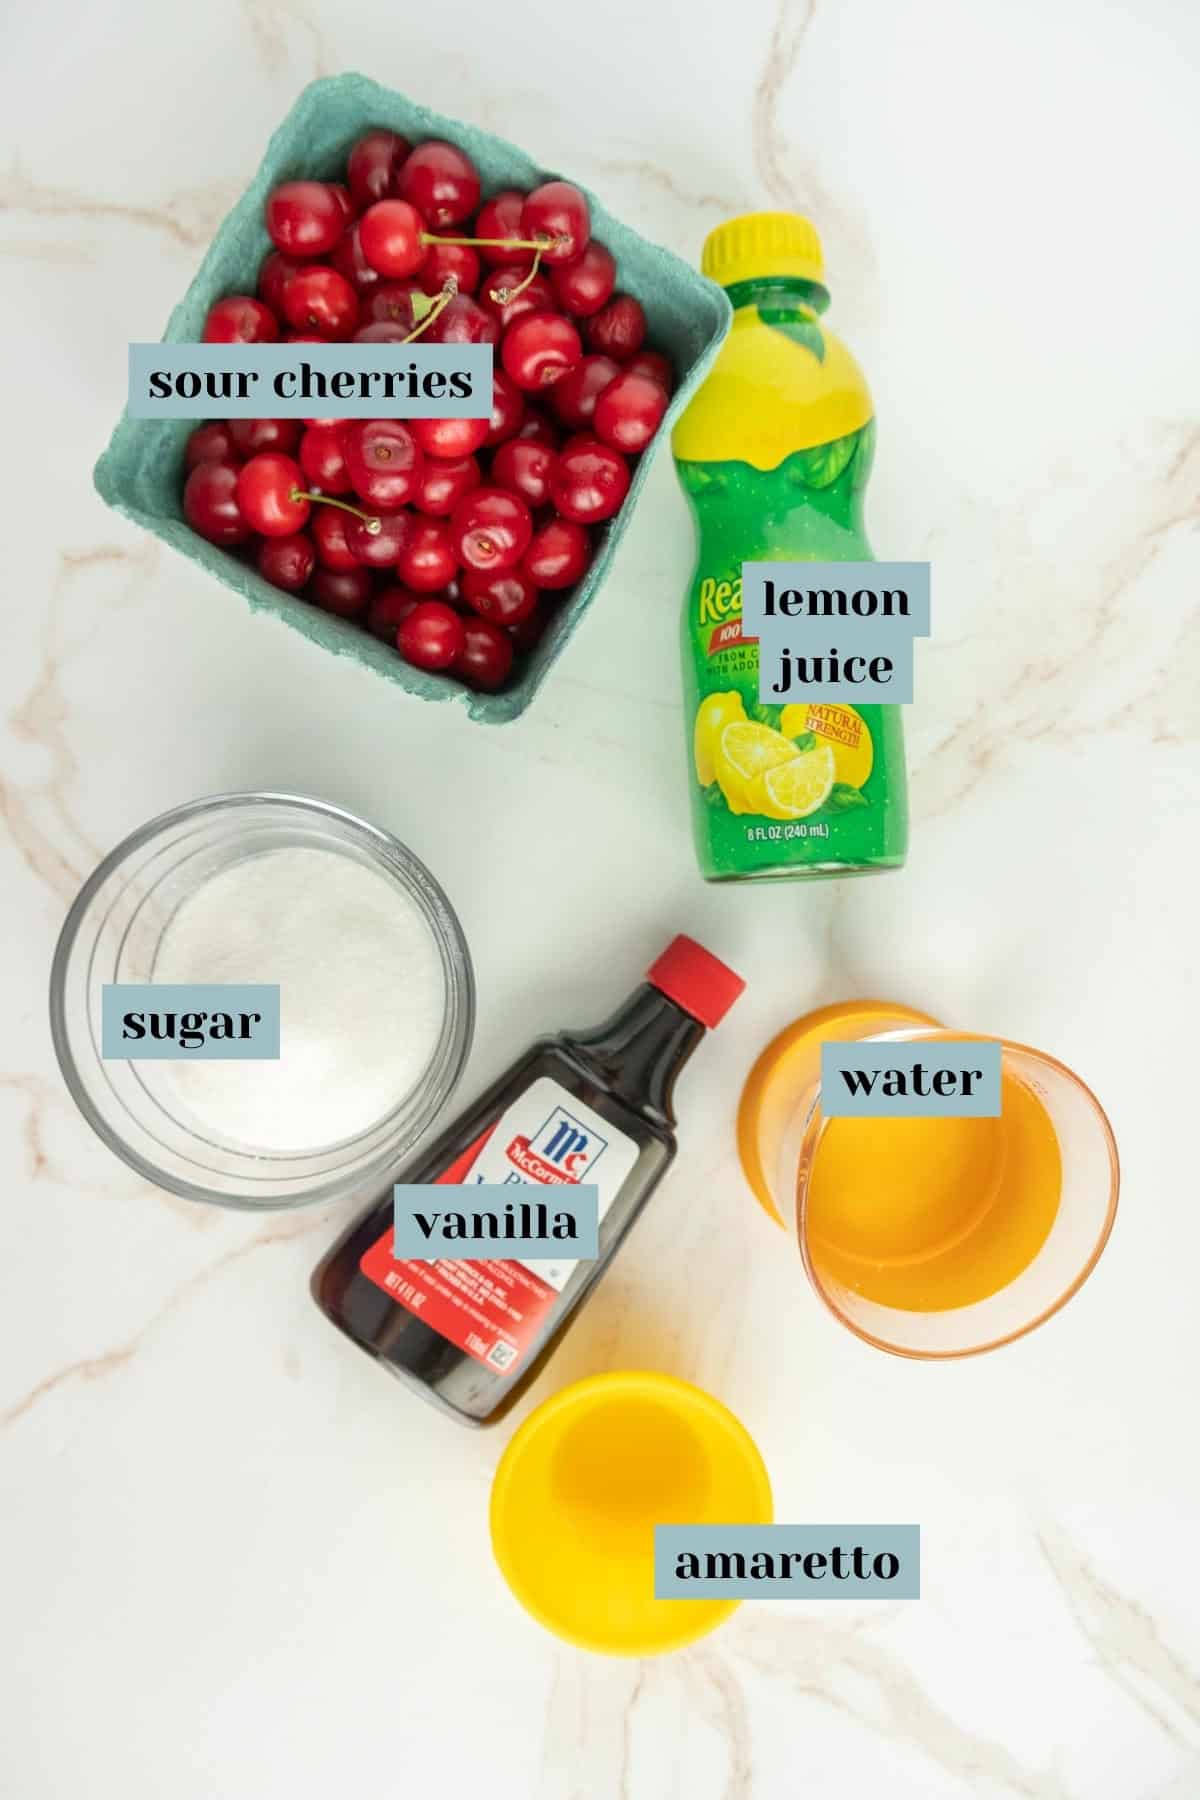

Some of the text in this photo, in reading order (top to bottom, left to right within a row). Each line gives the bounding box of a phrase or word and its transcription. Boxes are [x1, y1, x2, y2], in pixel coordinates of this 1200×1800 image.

[720, 625, 742, 641] 100
[808, 704, 863, 735] NATURAL
[805, 717, 860, 746] STRENGTH
[747, 823, 829, 841] 8 FL OZ (240 mL)
